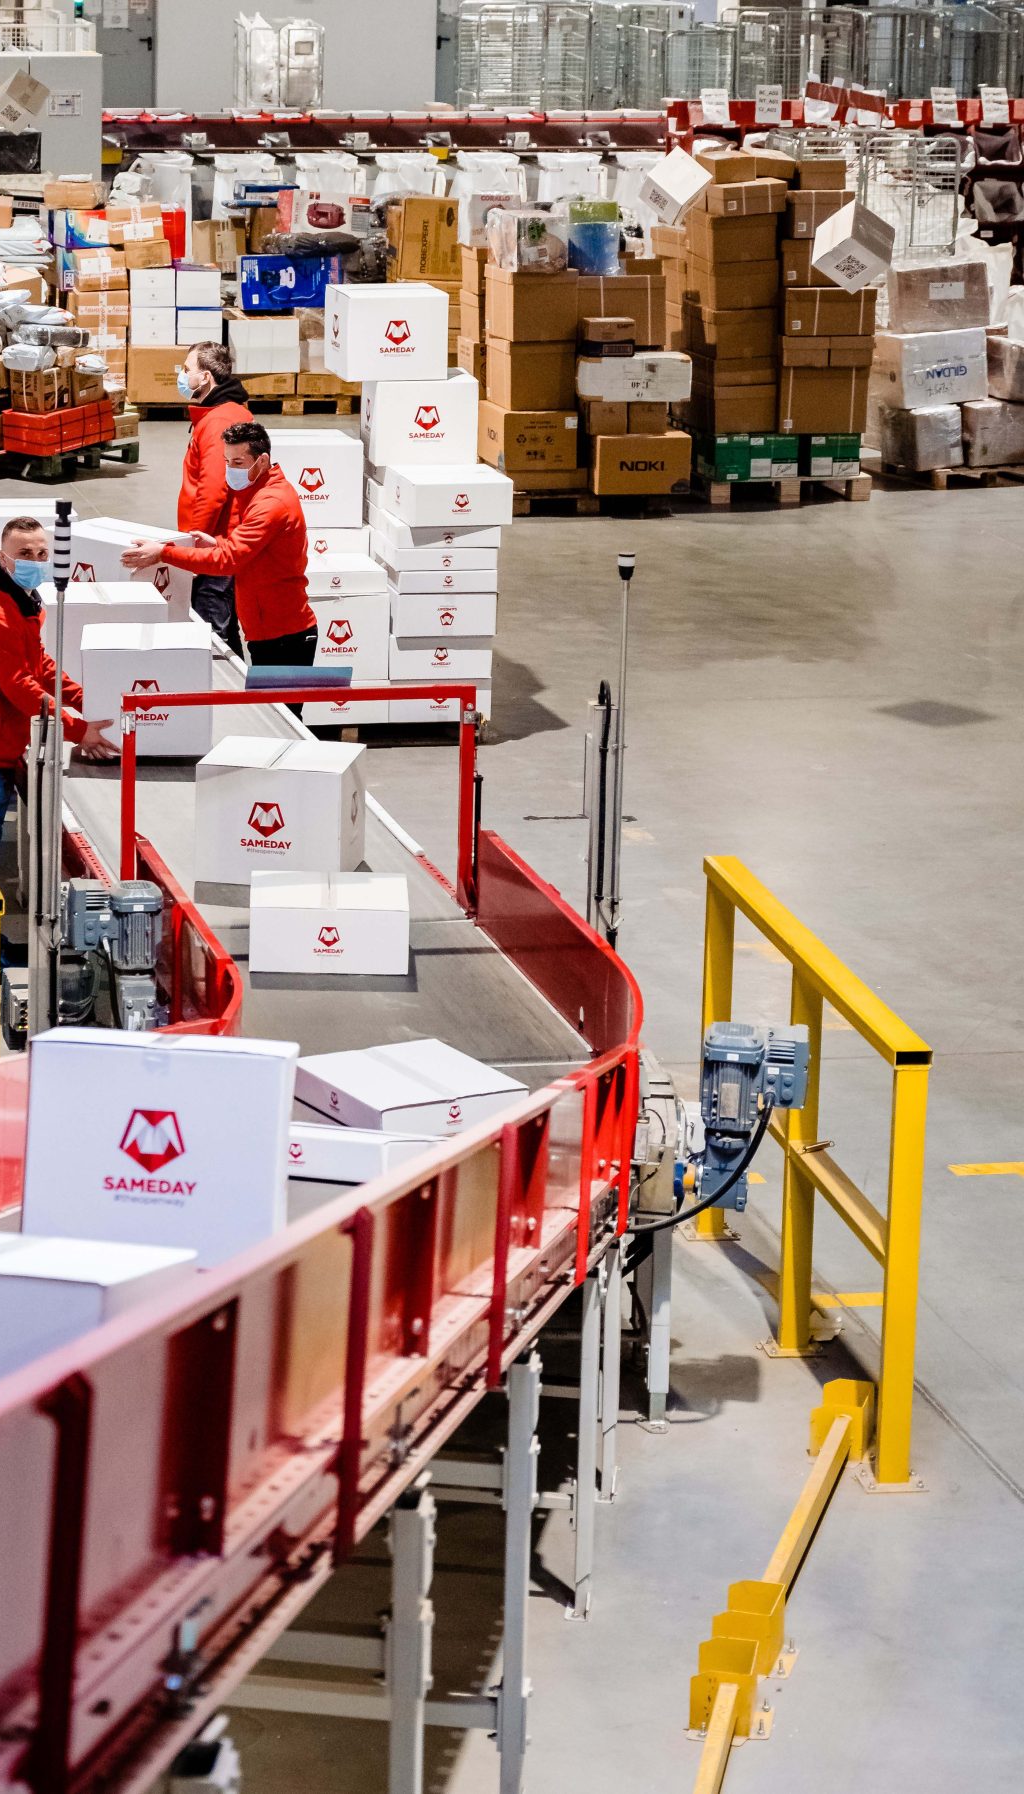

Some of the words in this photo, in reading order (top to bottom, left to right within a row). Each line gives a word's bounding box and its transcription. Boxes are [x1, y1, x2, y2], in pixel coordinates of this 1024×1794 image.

[420, 219, 429, 274] MOBEXPERT
[379, 346, 416, 354] SAMEDAY
[926, 365, 968, 379] GILDAN
[619, 460, 665, 472] NOKI
[320, 646, 358, 654] SAMEDAY
[135, 713, 170, 721] MEDAY
[240, 838, 292, 850] SAMEDAY
[103, 1176, 197, 1196] SAMEDAY
